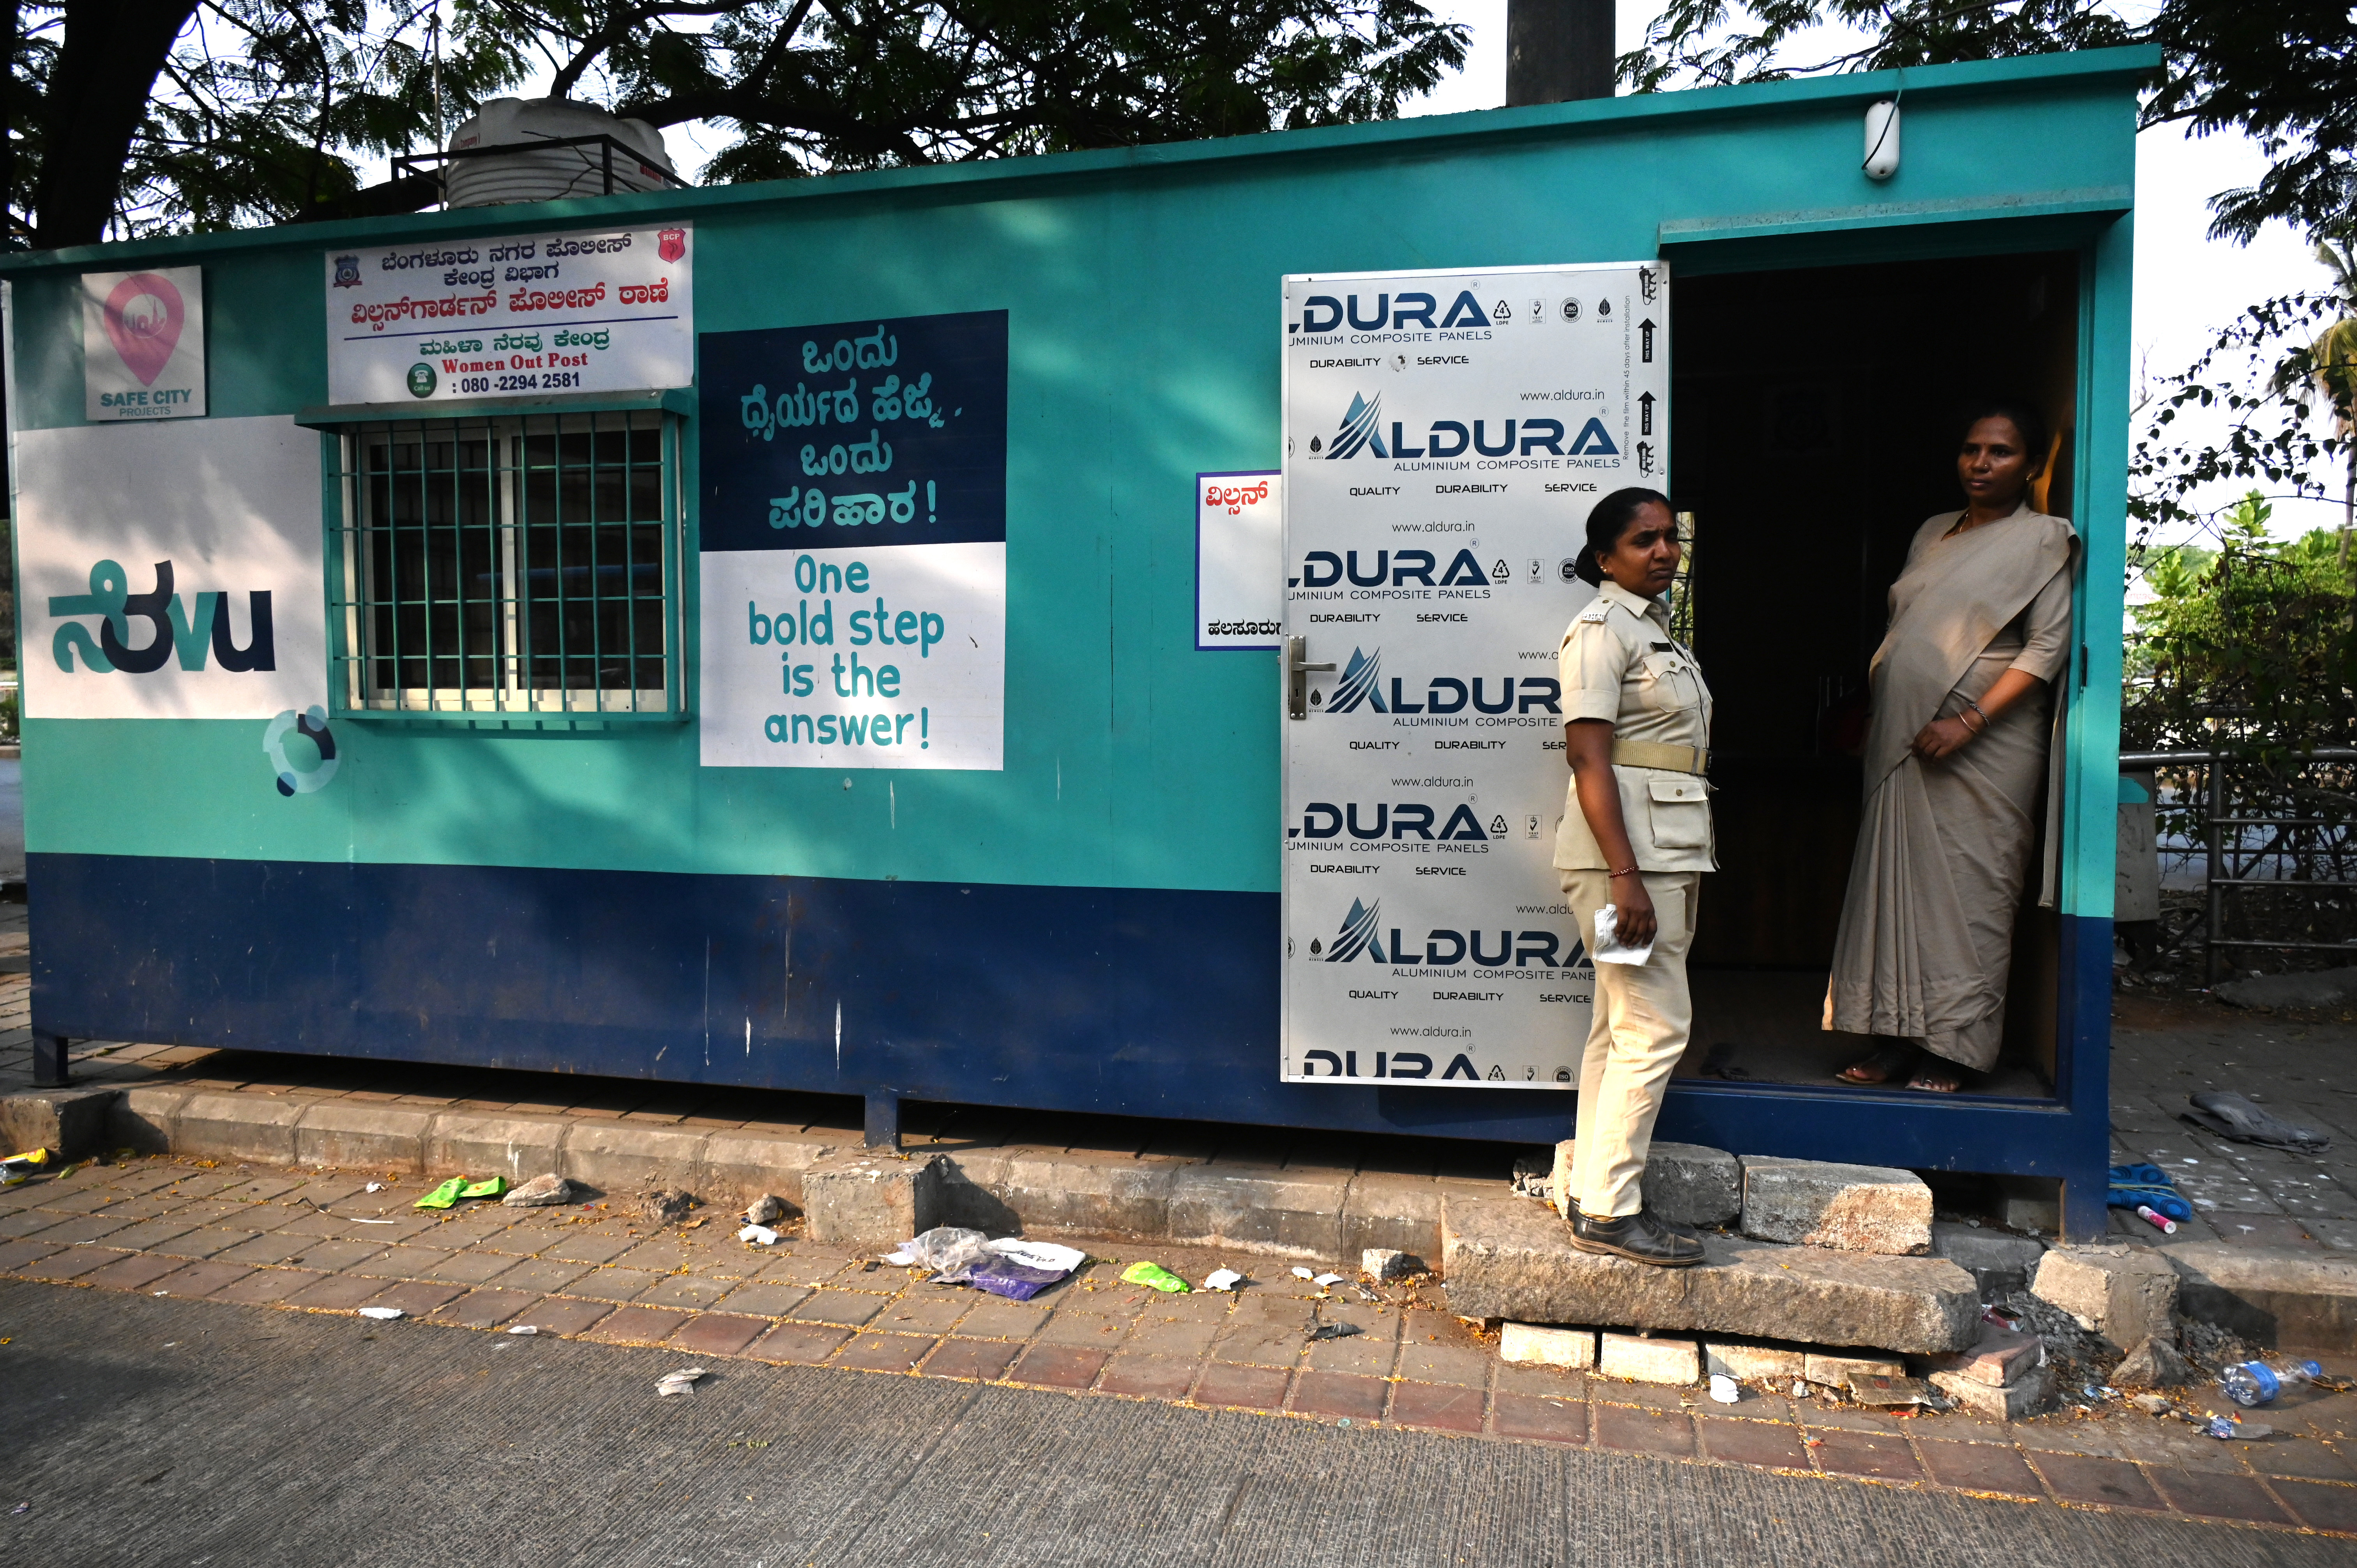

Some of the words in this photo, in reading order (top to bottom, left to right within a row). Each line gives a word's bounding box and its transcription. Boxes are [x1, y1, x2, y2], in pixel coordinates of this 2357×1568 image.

[382, 246, 479, 271] ಬೆಂಗಳೂರು
[489, 242, 535, 262] ನಗರ
[546, 233, 632, 257] ಪೊಲೀಸ್
[444, 266, 495, 290] ಕೇಂದ್ರ
[505, 261, 559, 283] ವಿಭಾಗ
[509, 282, 605, 312] ಪೊಲೀಸ್
[619, 277, 668, 304] ಠಾಣೆ
[1289, 291, 1491, 334] DURA
[420, 339, 482, 355] ಮಹಿಳಾ
[493, 332, 542, 352] ನೆರವು
[554, 328, 609, 350] ಕೇಂದ್ರ
[1351, 333, 1432, 344] COMPOSITE
[1440, 331, 1491, 341] PANELS
[802, 323, 897, 373] ಒಂದು
[442, 359, 505, 373] Women
[510, 355, 542, 369] Out
[548, 353, 588, 367] Post
[1310, 358, 1380, 368] DURABILITY
[1418, 356, 1469, 365] SERVICE
[462, 377, 489, 393] 080
[542, 372, 579, 388] 2581
[101, 390, 148, 407] SAFE
[153, 389, 191, 404] CITY
[1520, 389, 1604, 401] www.aldura.in
[119, 405, 171, 417] PROJECTS
[800, 429, 892, 476] ಒಂದು
[1394, 462, 1469, 471] ALUMINIUM
[1477, 460, 1559, 470] COMPOSITE
[1567, 459, 1620, 468] PANELS
[1350, 487, 1400, 496] QUALITY
[1436, 484, 1507, 493] DURABILITY
[1545, 484, 1597, 492] SERVICE
[1206, 481, 1267, 515] ವಿಲ್ಸನ್
[1392, 521, 1474, 532] www.aldura.in
[794, 554, 869, 593] One
[1288, 549, 1490, 588] DURA
[1350, 590, 1431, 599] COMPOSITE
[1439, 590, 1490, 599] PANELS
[1310, 614, 1380, 622] DURABILITY
[1417, 614, 1468, 622] SERVICE
[749, 599, 834, 645] bold
[850, 597, 944, 659] step
[782, 652, 814, 697] is
[831, 652, 900, 699] the
[764, 707, 928, 749] answer!
[1393, 718, 1468, 726] ALUMINIUM
[1475, 718, 1557, 726] COMPOSITE
[1350, 742, 1399, 750] QUALITY
[1542, 742, 1566, 750] SER
[1392, 776, 1473, 787] www.aldura.in
[1288, 803, 1488, 840] DURA
[1350, 843, 1430, 852] COMPOSITE
[1438, 844, 1488, 853] PANELS
[1311, 865, 1380, 873] DURABILITY
[1416, 867, 1466, 875] SERVICE
[1392, 968, 1466, 978] ALUMINIUM
[1474, 970, 1554, 980] COMPOSITE
[1562, 971, 1595, 980] PANE
[1349, 991, 1398, 999] QUALITY
[1433, 992, 1504, 1001] DURABILITY
[1540, 994, 1591, 1003] SERVICE
[1391, 1026, 1471, 1037] www.aldura.in
